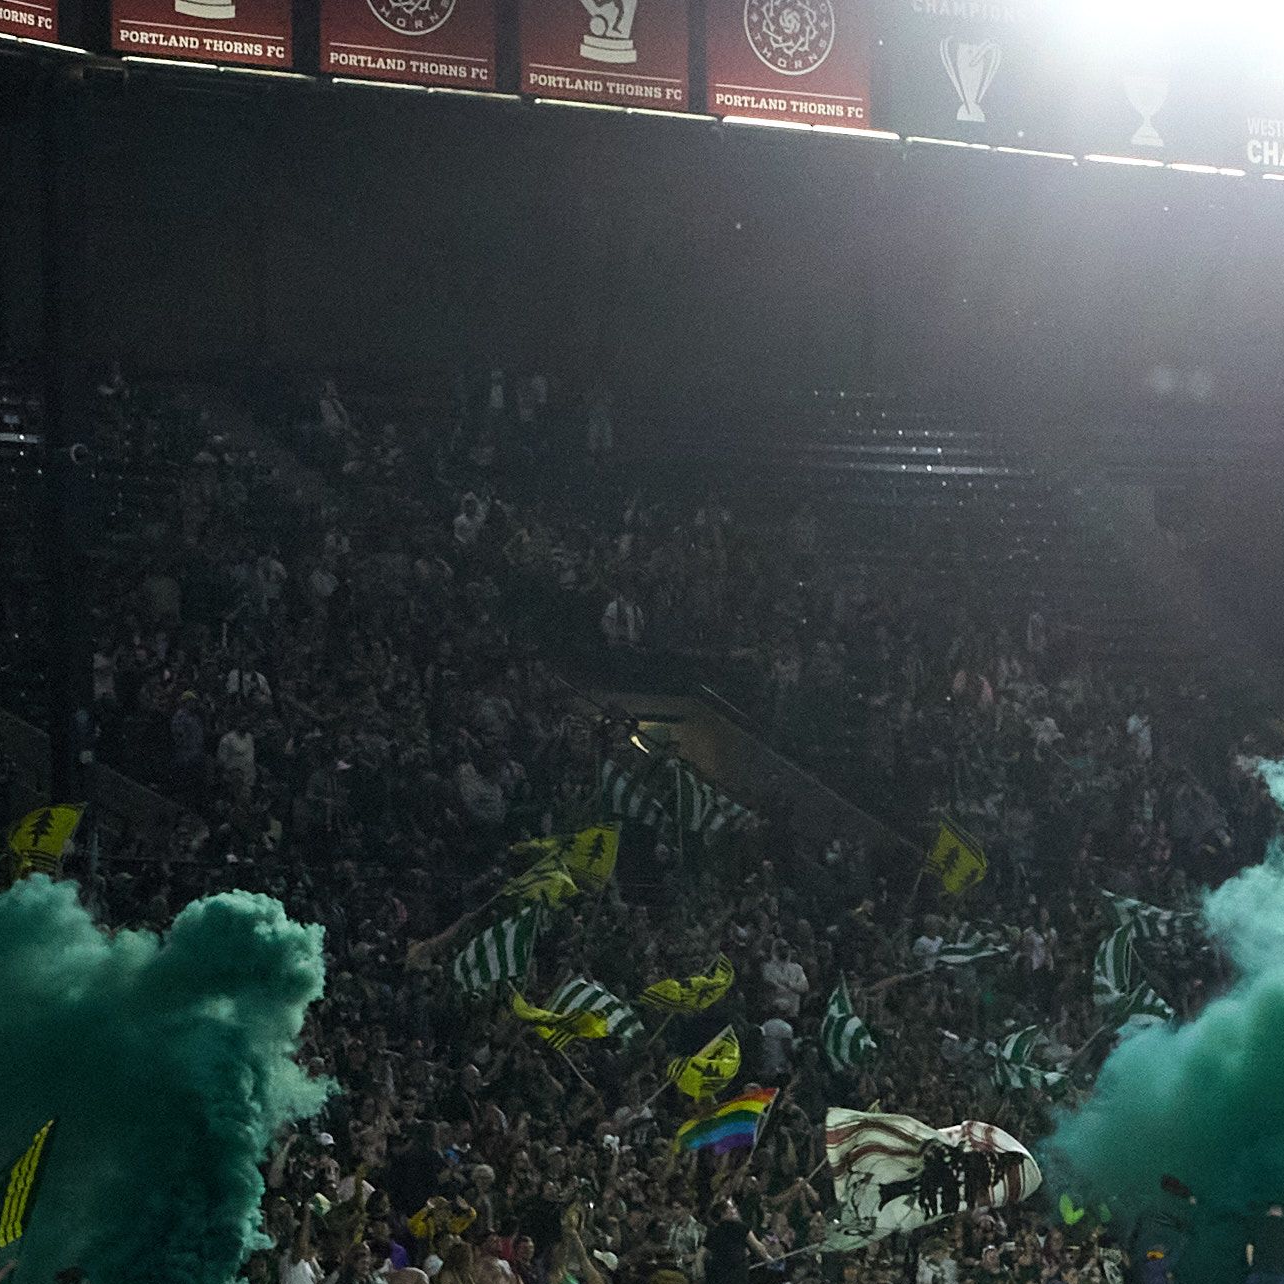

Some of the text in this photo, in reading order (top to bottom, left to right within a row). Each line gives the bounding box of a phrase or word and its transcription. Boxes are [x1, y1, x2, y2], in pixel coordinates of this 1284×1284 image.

[37, 16, 53, 30] FC
[119, 29, 285, 59] PORTLAND THORNS FC
[329, 51, 489, 81] PORTLAND THORNS FC
[529, 72, 683, 101] PORTLAND THORNS FC
[715, 93, 864, 119] PORTLAND THORNS FC
